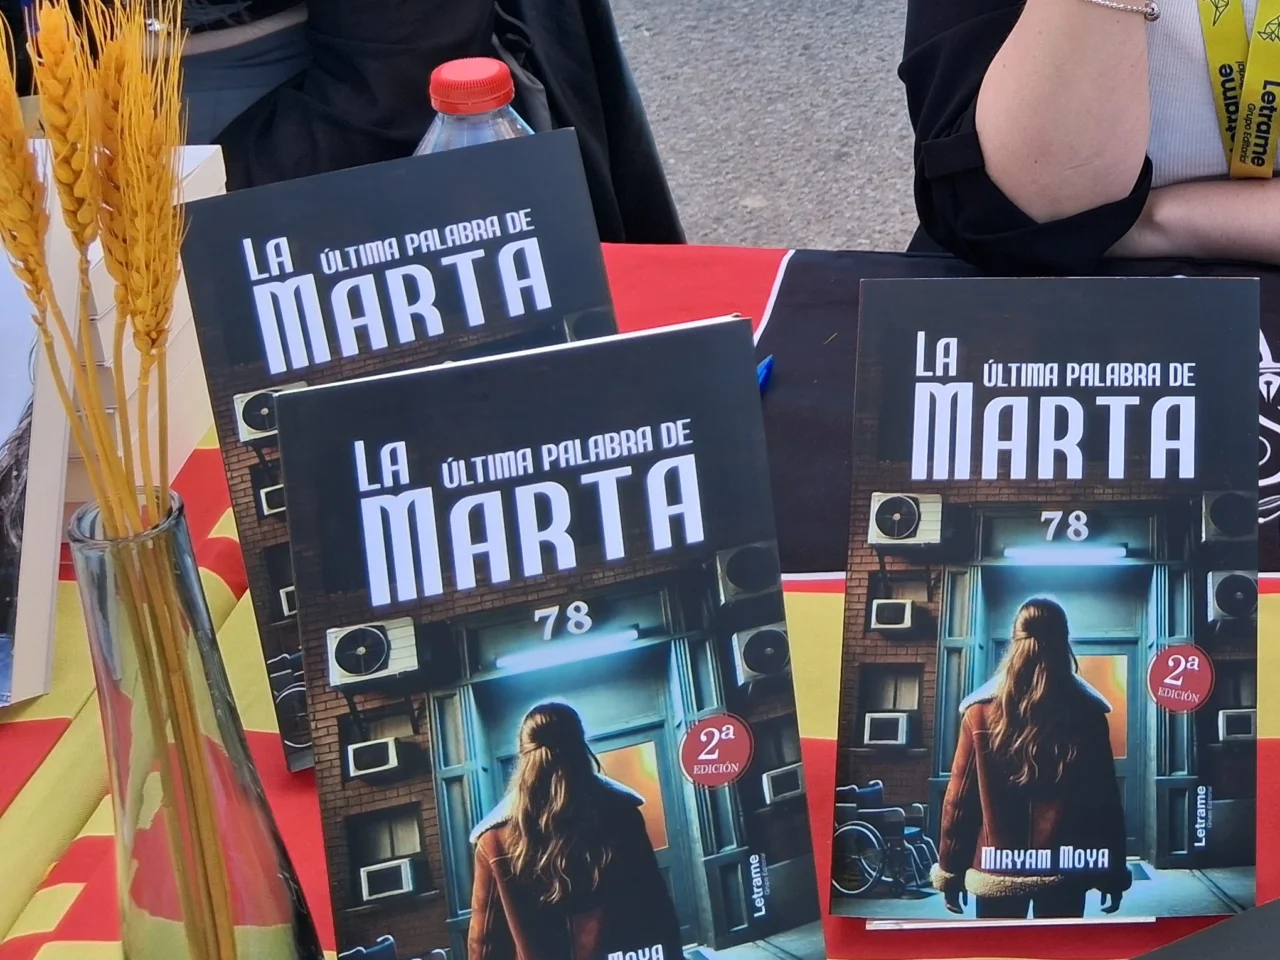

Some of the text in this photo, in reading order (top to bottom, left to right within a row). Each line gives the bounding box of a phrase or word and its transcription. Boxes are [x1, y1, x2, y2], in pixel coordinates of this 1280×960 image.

[1243, 103, 1256, 131] Grupo
[242, 236, 293, 282] LA
[319, 208, 535, 276] ÚLTIMA PALABRA DE
[252, 236, 553, 375] MARTA
[915, 330, 958, 378] LA
[982, 358, 1196, 388] ÚLTIMA PALABRA DE
[441, 418, 694, 490] ÚLTIMA PALABRA DE
[911, 381, 1197, 481] MARTA
[354, 440, 410, 493] LA
[360, 452, 705, 608] MARTA
[1040, 510, 1090, 542] 78
[534, 600, 593, 641] 78
[1157, 686, 1201, 705] EDICIÓN
[692, 761, 740, 776] EDICIÓN
[1193, 785, 1207, 847] Letrame
[1059, 845, 1109, 870] MOYA
[749, 853, 766, 918] Letrame
